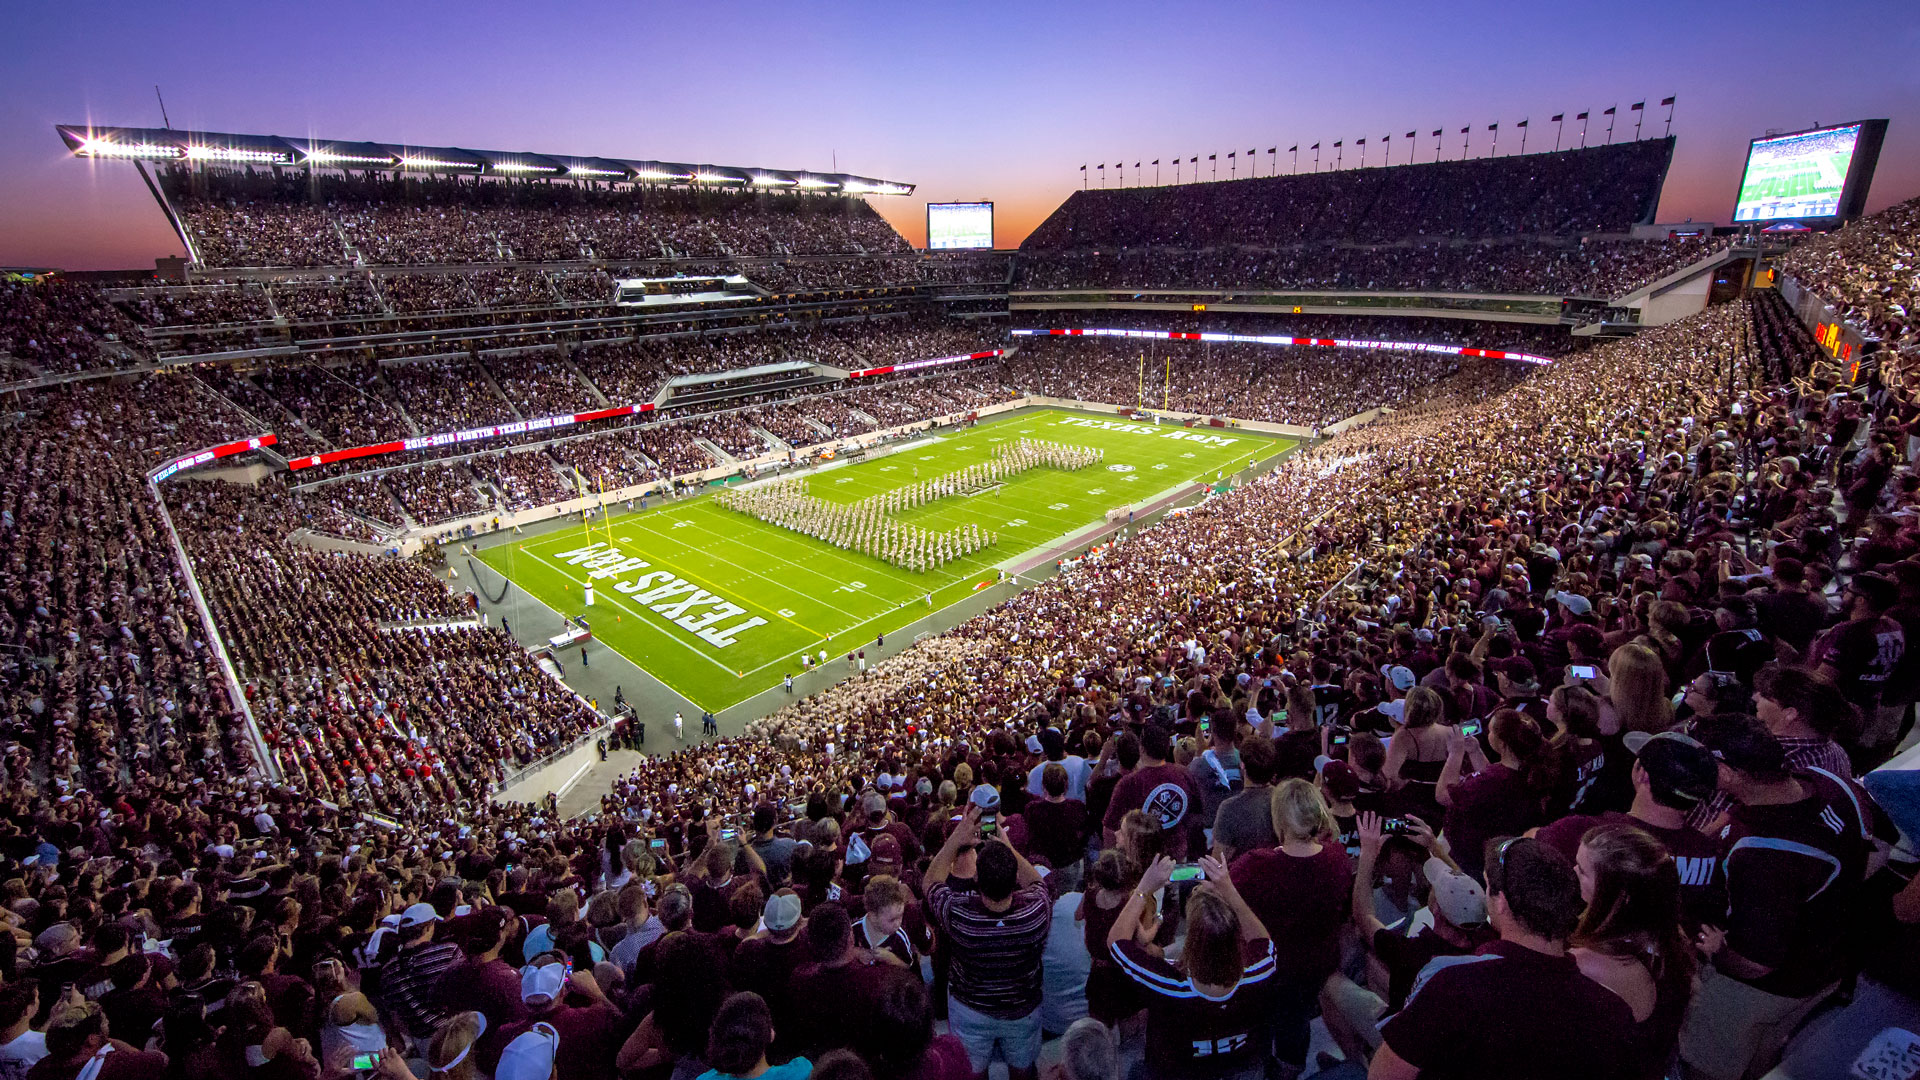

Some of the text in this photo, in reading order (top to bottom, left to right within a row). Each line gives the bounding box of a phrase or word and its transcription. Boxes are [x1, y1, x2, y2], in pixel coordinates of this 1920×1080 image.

[1394, 342, 1417, 350] SPIRIT
[499, 421, 527, 435] TEXAS
[527, 418, 551, 431] AGGIE
[553, 414, 575, 426] BAND
[1059, 416, 1239, 447] TEXAS A&M
[552, 541, 654, 580] A&M
[612, 570, 771, 649] TEXAS
